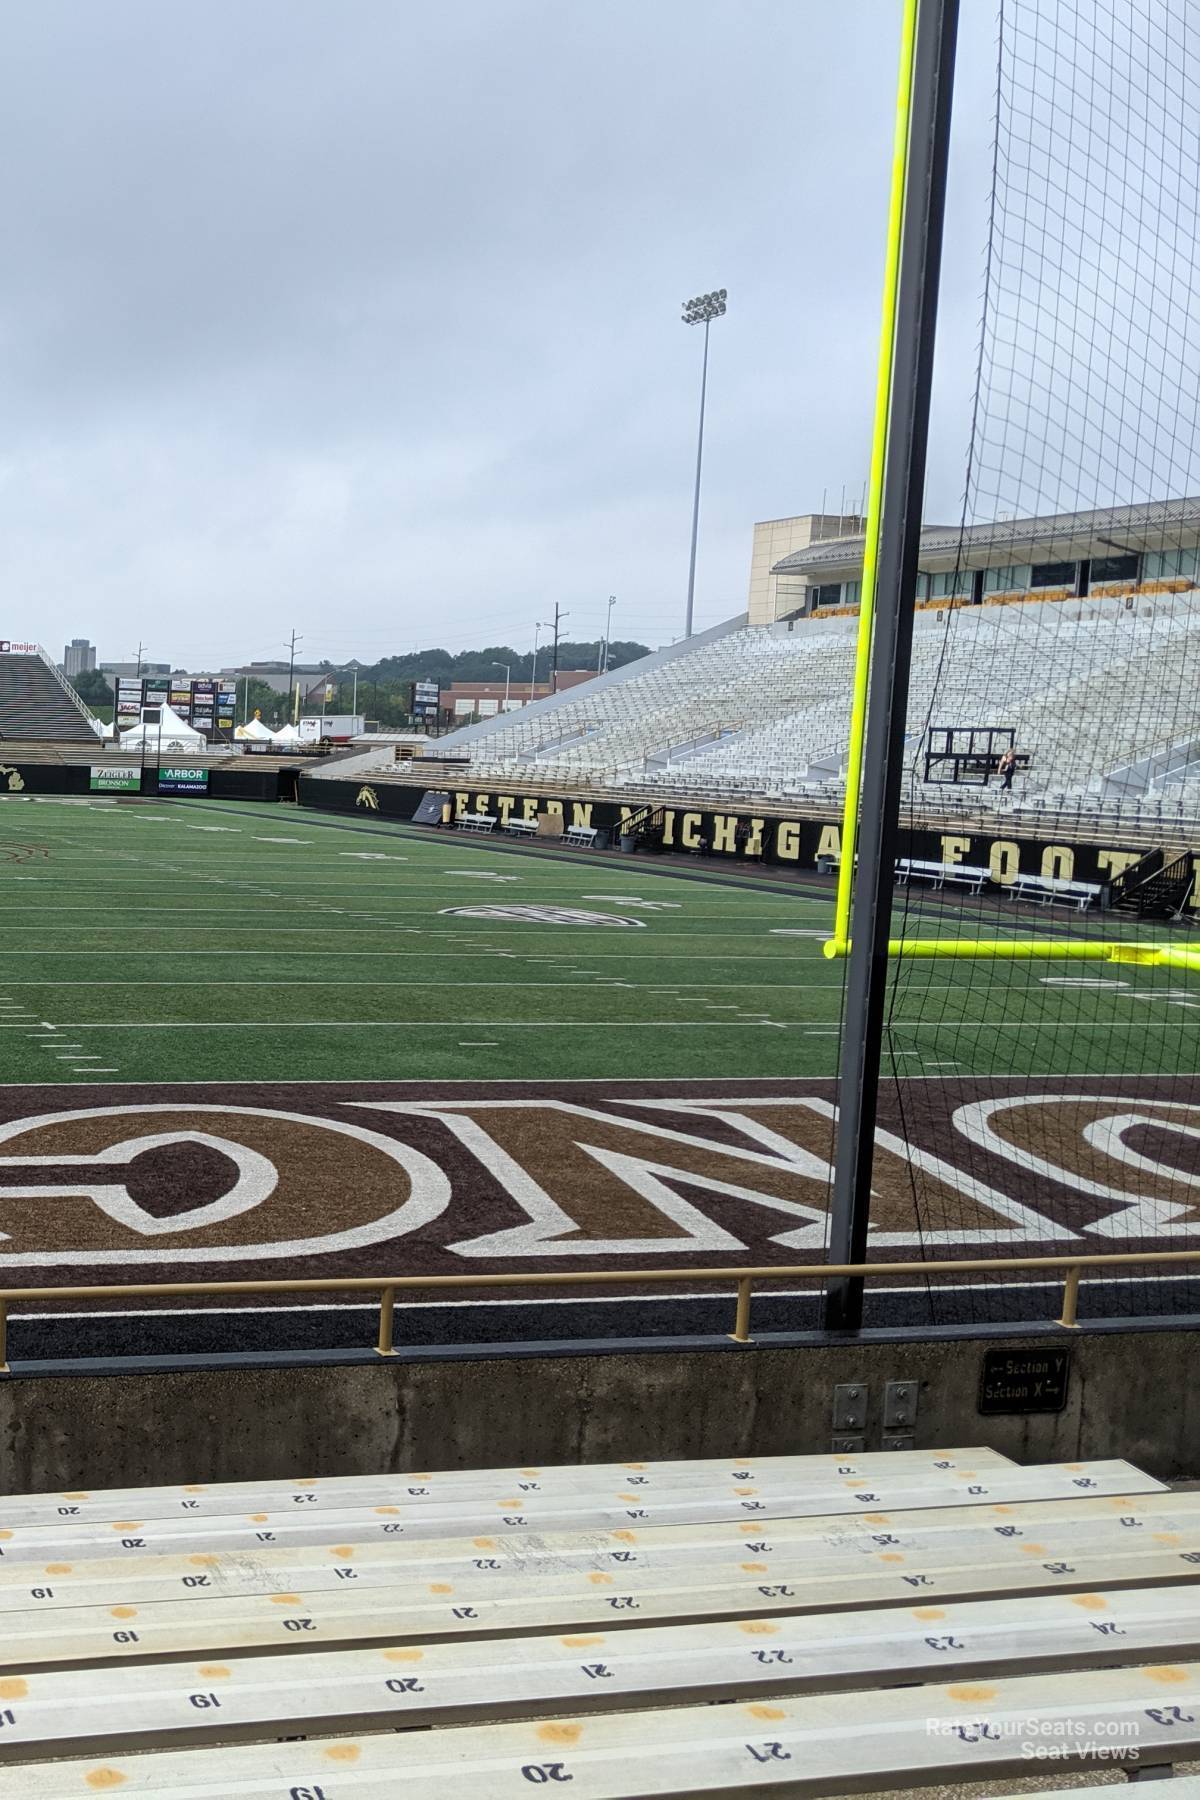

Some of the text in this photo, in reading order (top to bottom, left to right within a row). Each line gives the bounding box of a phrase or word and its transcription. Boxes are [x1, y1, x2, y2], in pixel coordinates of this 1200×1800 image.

[11, 642, 37, 652] meijer
[165, 768, 203, 779] ARBOR
[1005, 1358, 1064, 1374] Section Y
[985, 1382, 1043, 1399] Section X
[838, 1467, 857, 1475] 27
[626, 1476, 650, 1485] 25
[1071, 1478, 1098, 1488] 28
[407, 1487, 430, 1496] 23
[518, 1482, 541, 1492] 24
[967, 1485, 989, 1495] 27
[181, 1500, 200, 1510] 21
[292, 1494, 318, 1504] 22
[57, 1506, 81, 1516] 20
[740, 1501, 767, 1511] 25
[626, 1509, 650, 1519] 24
[502, 1516, 528, 1526] 23
[1119, 1517, 1143, 1527] 27
[380, 1523, 404, 1534] 22
[255, 1531, 277, 1542] 21
[871, 1534, 901, 1546] 25
[121, 1538, 147, 1549] 20
[744, 1542, 773, 1553] 24
[612, 1551, 638, 1563] 23
[472, 1559, 502, 1570] 22
[1042, 1562, 1076, 1575] 25
[333, 1567, 359, 1579] 21
[181, 1575, 212, 1588] 20
[900, 1574, 935, 1587] 24
[30, 1587, 54, 1600] 19
[757, 1585, 795, 1598] 23
[604, 1596, 640, 1610] 22
[451, 1607, 479, 1620] 21
[282, 1618, 317, 1631] 20
[1089, 1621, 1127, 1636] 24
[112, 1630, 138, 1644] 19
[924, 1635, 965, 1652] 23
[750, 1649, 794, 1665] 22
[580, 1663, 616, 1680] 21
[384, 1677, 425, 1694] 20
[188, 1692, 222, 1709] 19
[1144, 1705, 1195, 1727] 23
[745, 1741, 792, 1764] 21
[520, 1762, 574, 1785] 20
